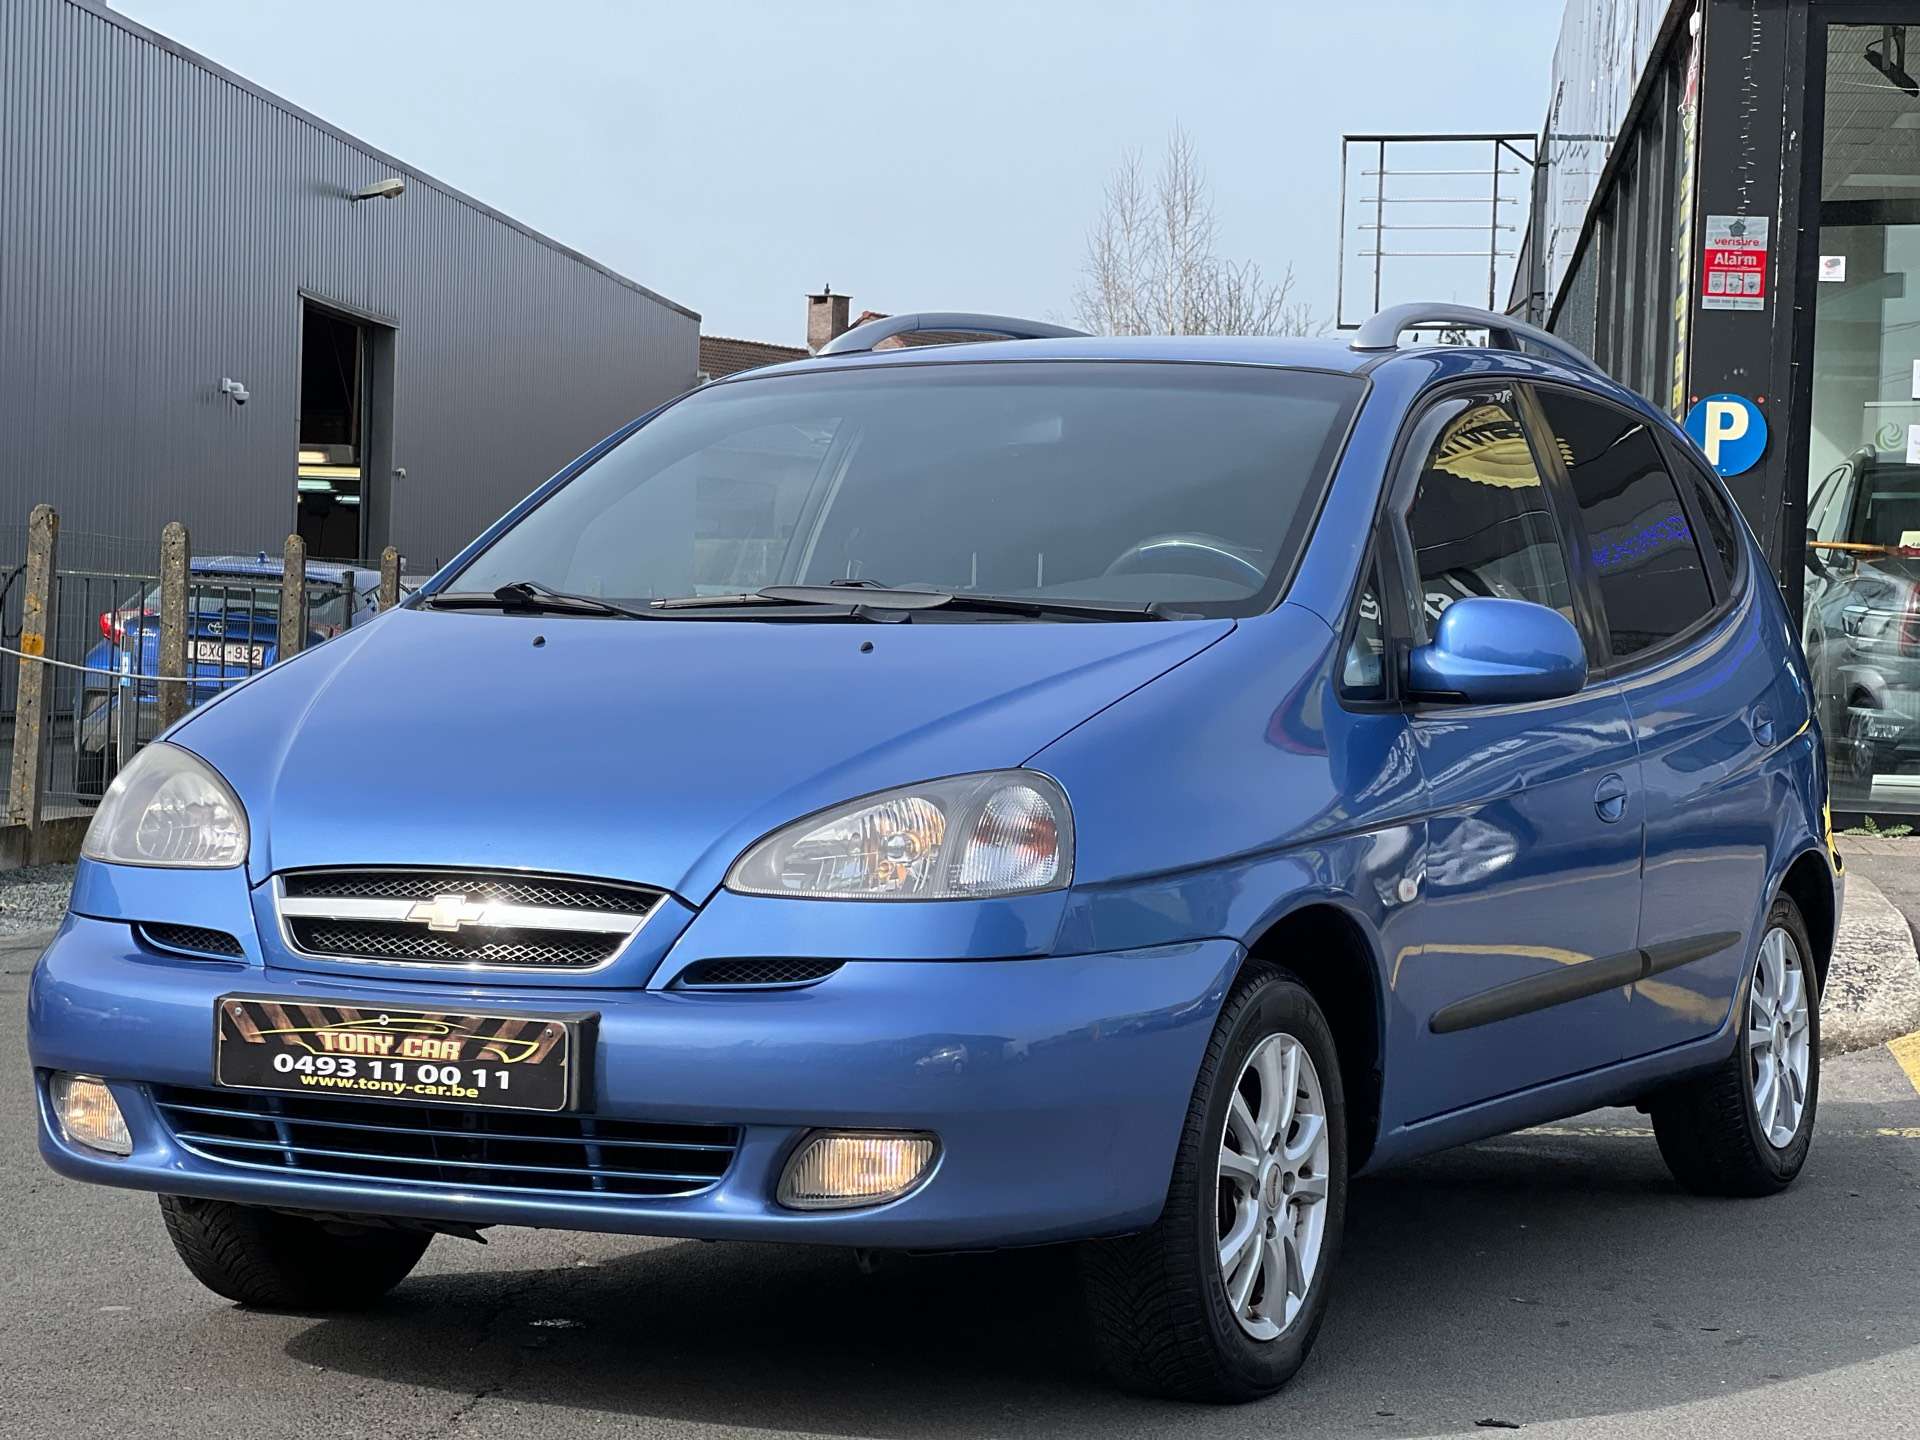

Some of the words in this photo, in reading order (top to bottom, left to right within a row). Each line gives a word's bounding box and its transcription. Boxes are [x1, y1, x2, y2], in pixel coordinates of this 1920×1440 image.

[1714, 238, 1760, 247] verisure
[1714, 252, 1757, 266] Alarm
[1704, 401, 1749, 466] P
[315, 1032, 395, 1055] TONY
[403, 1037, 462, 1061] CAR
[273, 1053, 357, 1078] 0493
[368, 1060, 404, 1082] 11
[417, 1064, 462, 1086] 00
[472, 1068, 509, 1090] 11
[300, 1074, 480, 1099] www.tony-car.be
